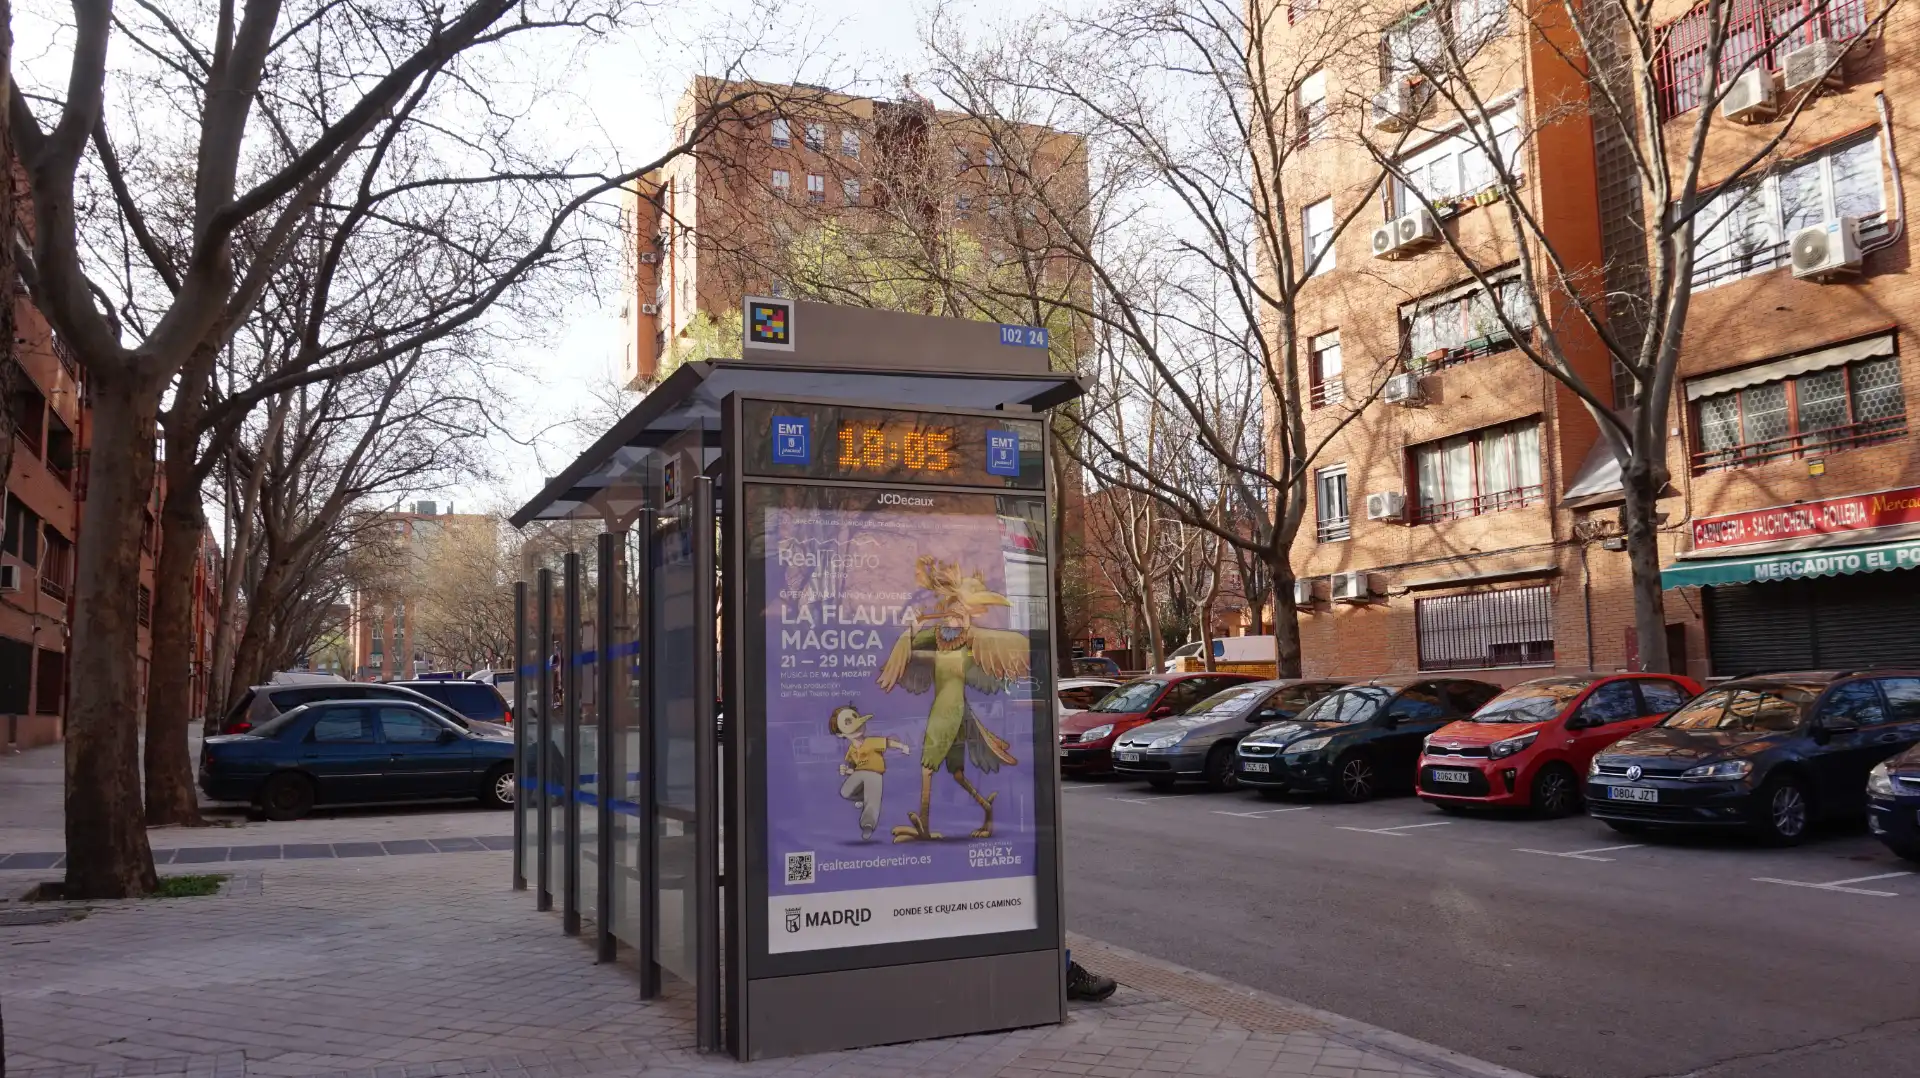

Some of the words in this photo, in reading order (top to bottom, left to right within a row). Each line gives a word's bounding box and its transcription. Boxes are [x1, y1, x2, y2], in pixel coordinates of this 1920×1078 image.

[1001, 327, 1022, 343] 102
[1028, 330, 1044, 345] 24
[778, 423, 804, 435] EMT
[838, 428, 949, 471] 18:05
[991, 437, 1014, 448] EMT
[877, 493, 934, 507] JCDecaux
[1695, 518, 1746, 545] CARNICERIA
[1752, 508, 1816, 537] SALCHICHERIA
[1823, 502, 1867, 527] POLLERIA
[1754, 554, 1860, 579] MERCADITO
[1866, 551, 1891, 567] EL
[867, 591, 872, 600] Y
[781, 604, 814, 625] LA
[823, 604, 918, 625] FLAUTA
[781, 622, 883, 650] MÁGICA
[780, 655, 796, 668] 21
[819, 655, 838, 668] 29
[843, 654, 877, 667] MAR
[809, 671, 820, 679] DE
[841, 670, 871, 678] MOZART
[1436, 771, 1453, 781] 2062
[1613, 787, 1635, 799] 0804
[1638, 789, 1656, 801] JZT
[1006, 847, 1013, 856] Y
[817, 854, 932, 872] realteatroderetiro.es
[969, 856, 1022, 868] VELARDE
[893, 907, 922, 918] DONDE
[924, 906, 934, 915] SE
[935, 902, 967, 915] CRUZAN
[969, 901, 985, 911] LOS
[986, 897, 1021, 909] CAMINOS
[805, 907, 872, 927] MADRID
